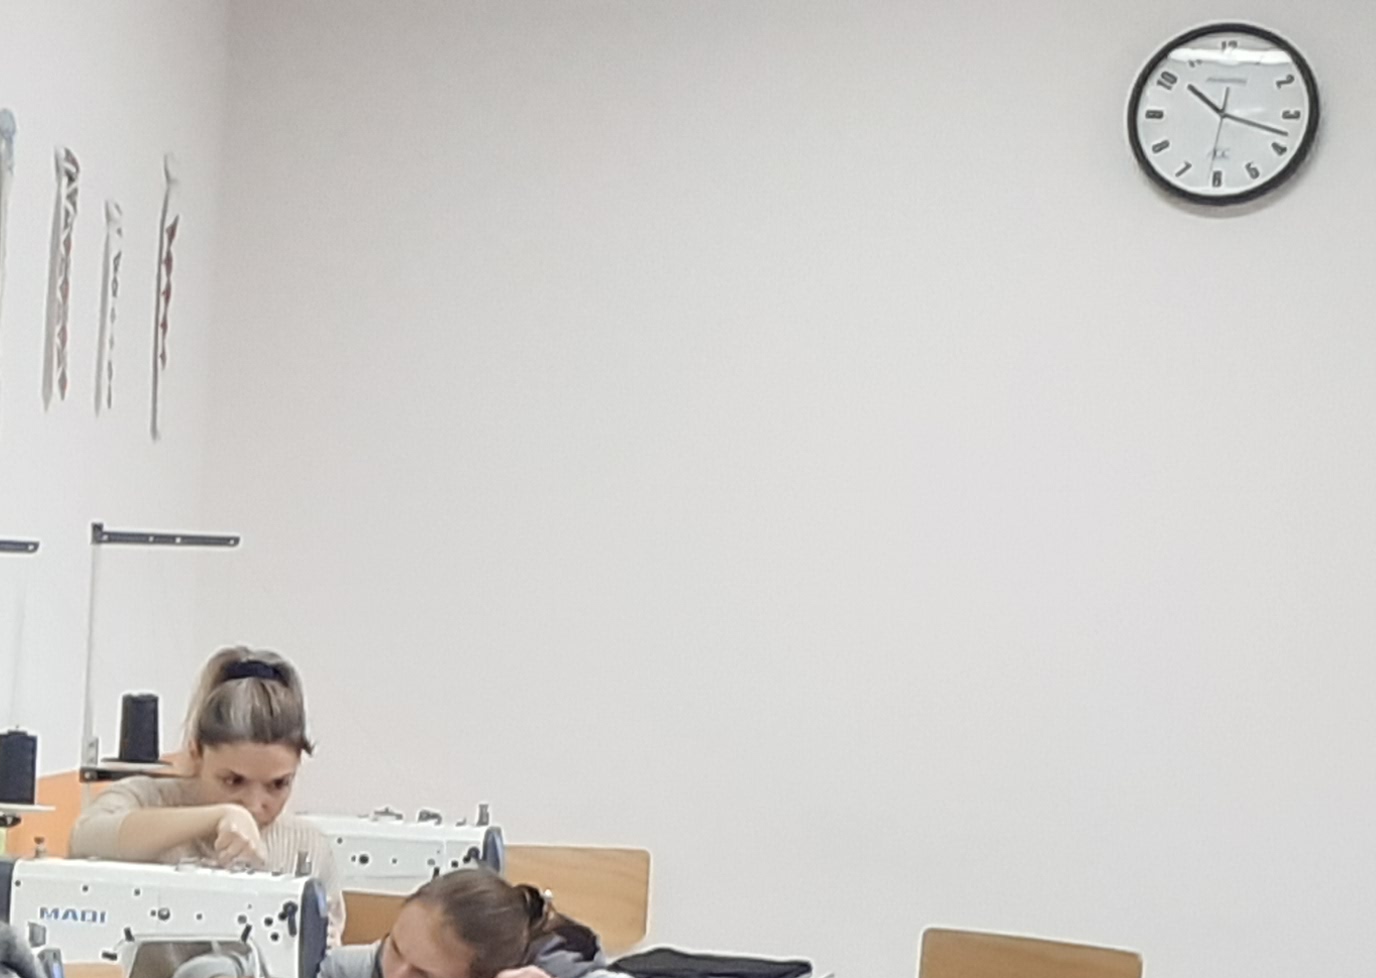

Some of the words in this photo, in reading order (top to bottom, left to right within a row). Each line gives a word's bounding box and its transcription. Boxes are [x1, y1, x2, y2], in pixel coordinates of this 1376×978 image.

[1156, 71, 1178, 90] 10
[1275, 74, 1295, 90] 2
[1270, 141, 1288, 156] 4
[1175, 161, 1192, 177] 7
[1244, 161, 1260, 180] 5
[1211, 170, 1223, 188] 6
[39, 906, 106, 923] MADI
